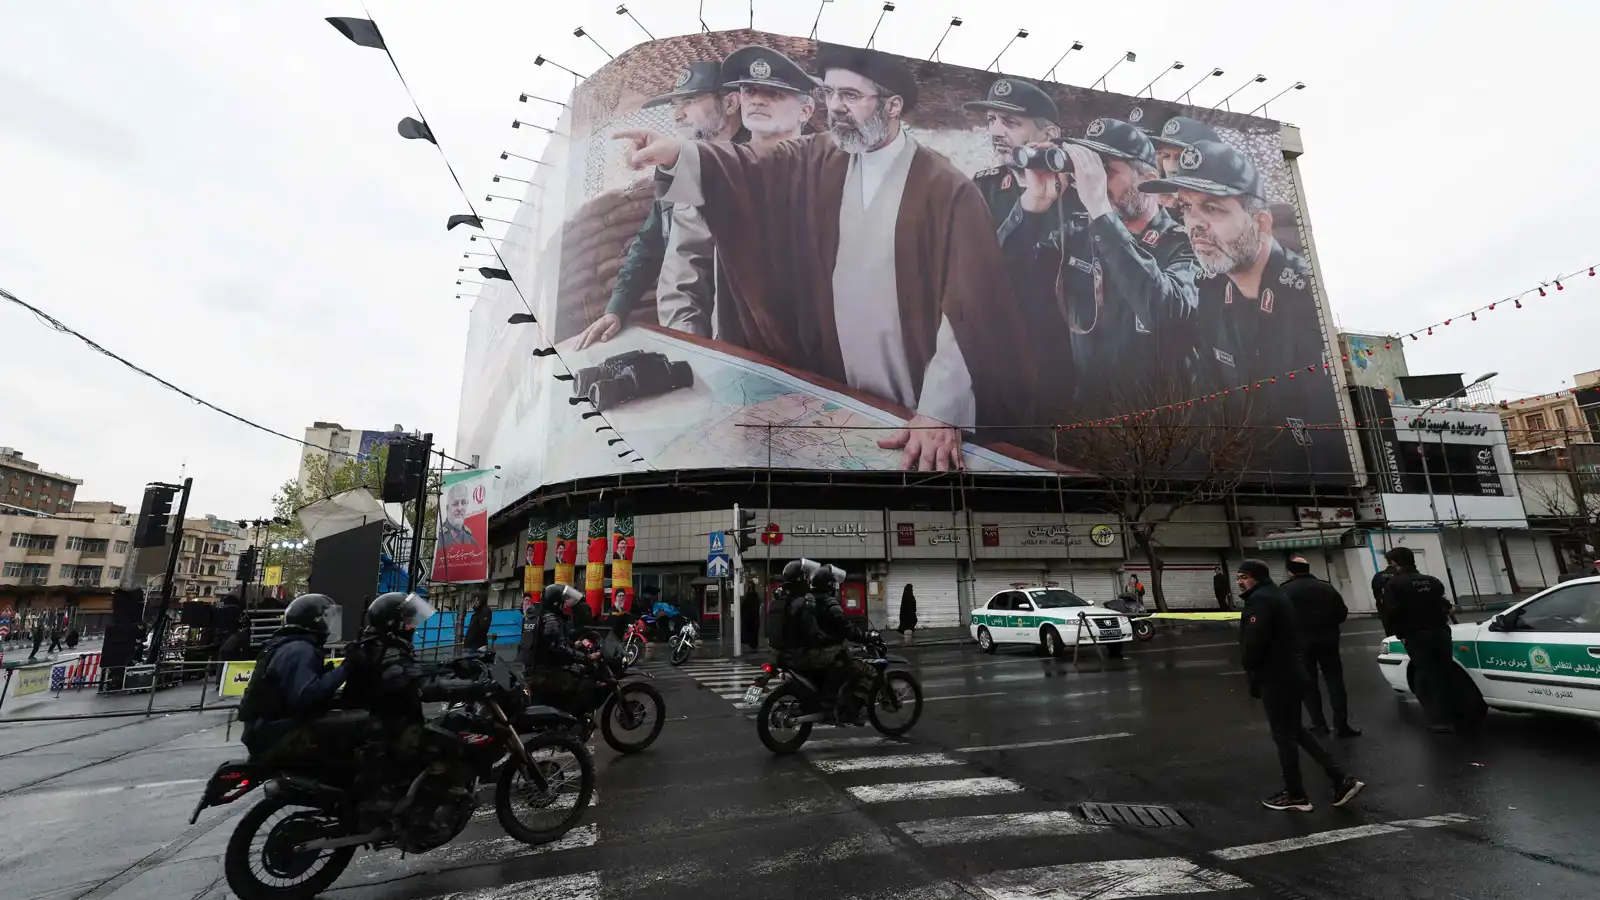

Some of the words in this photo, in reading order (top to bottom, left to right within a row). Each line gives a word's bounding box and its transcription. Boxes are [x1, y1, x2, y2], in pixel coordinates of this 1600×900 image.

[1384, 441, 1403, 492] SAMSUNG
[791, 522, 828, 537] ملت
[832, 522, 868, 542] بانک
[1028, 526, 1047, 537] ملی
[1485, 655, 1507, 667] بزرگ
[1507, 658, 1528, 669] تهران
[1552, 660, 1573, 671] انتظامی
